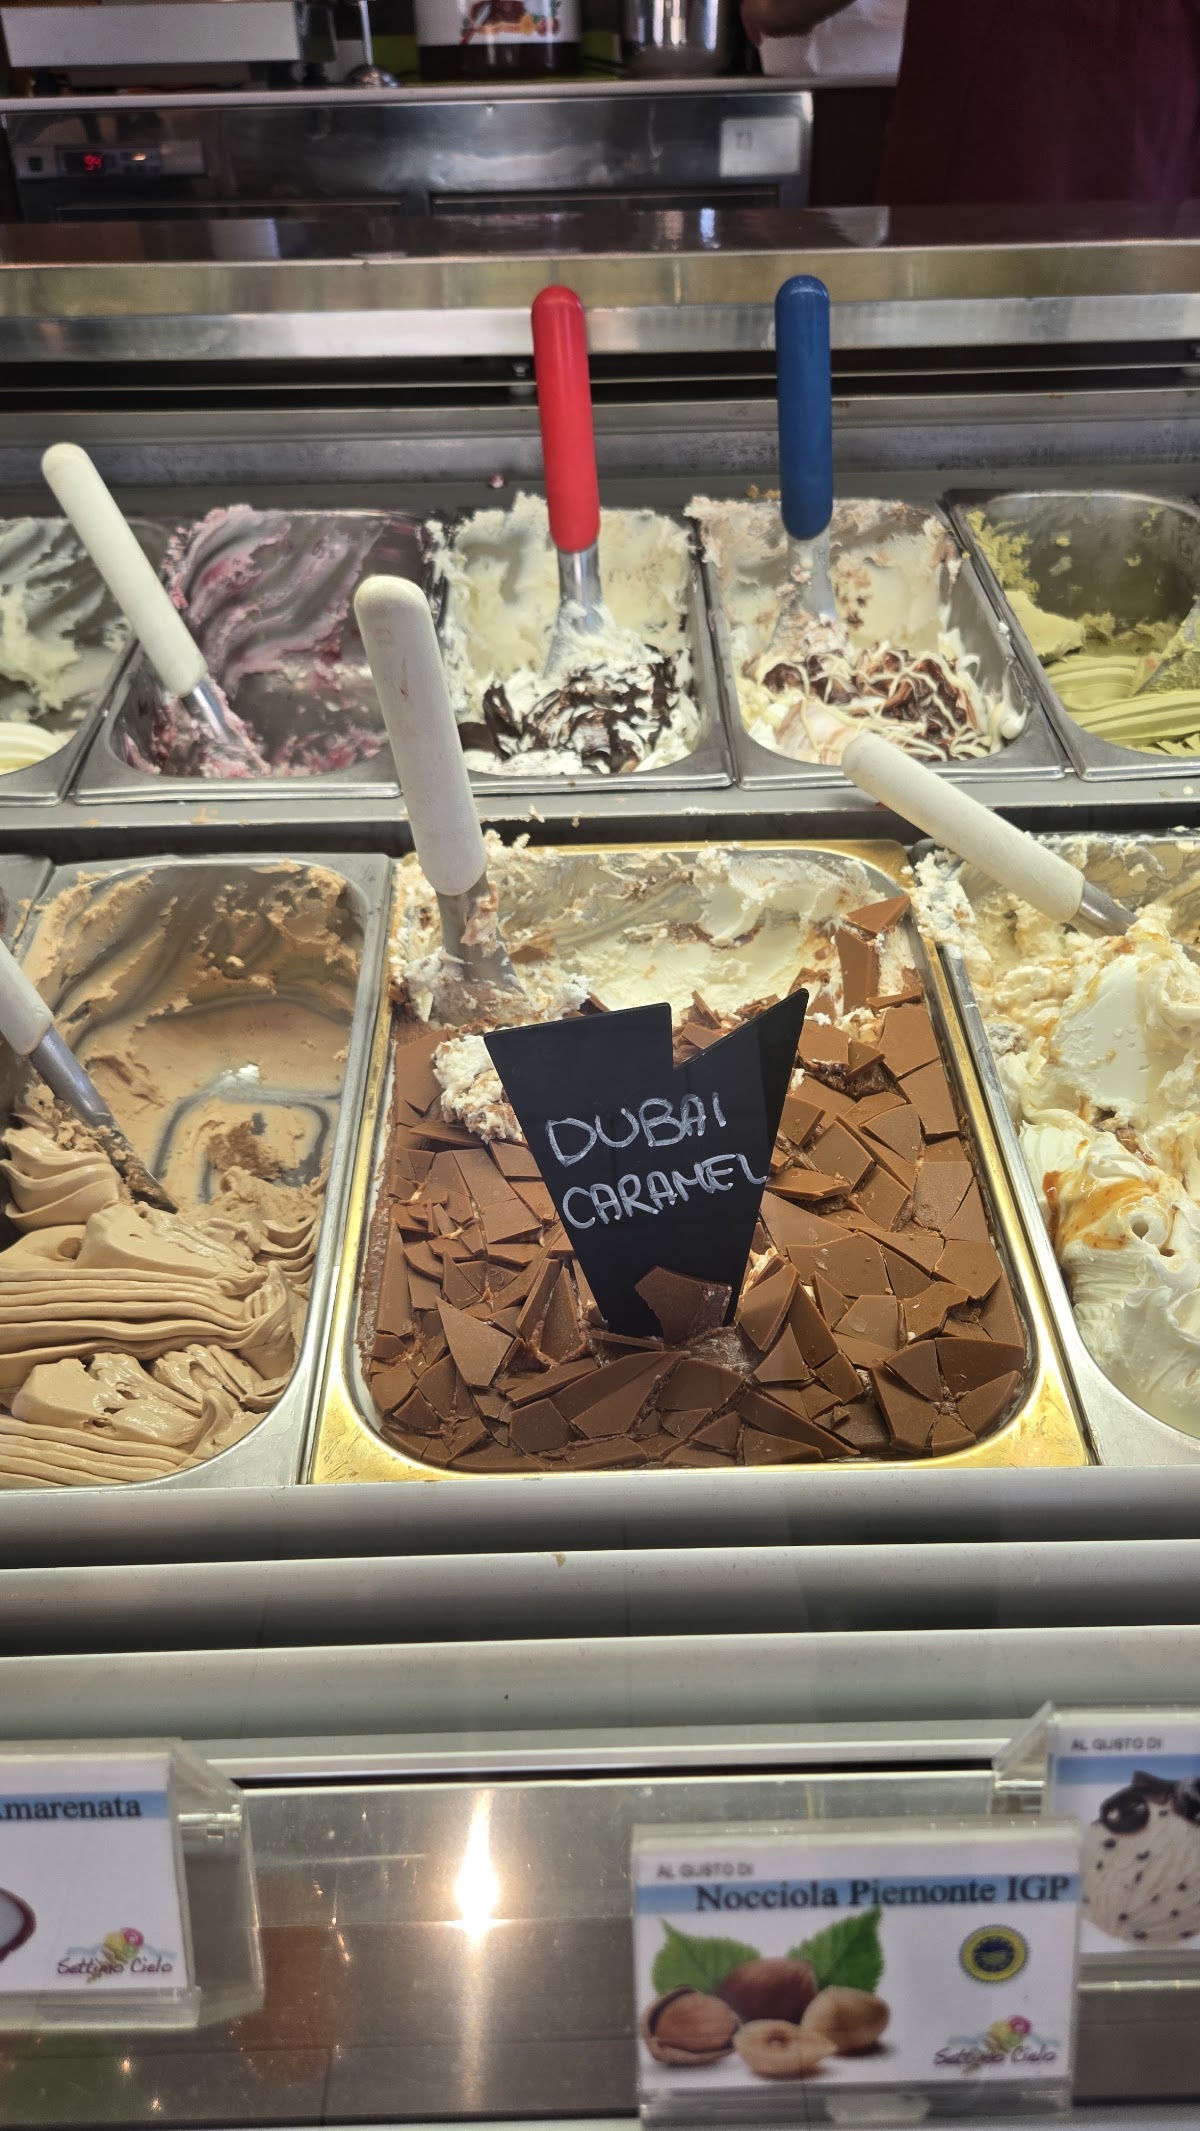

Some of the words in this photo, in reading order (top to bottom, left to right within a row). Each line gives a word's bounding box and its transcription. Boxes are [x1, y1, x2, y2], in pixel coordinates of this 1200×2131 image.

[545, 1092, 727, 1168] DUBAI
[562, 1153, 768, 1229] CARAMEL
[1071, 1738, 1088, 1751] AL
[1092, 1737, 1143, 1751] GUSTO
[1147, 1737, 1163, 1749] DI
[0, 1796, 142, 1820] marenata
[657, 1864, 675, 1878] AL
[679, 1862, 735, 1878] GUSTO
[695, 1880, 839, 1912] Nocciola
[849, 1876, 997, 1907] Piemonte
[1006, 1873, 1071, 1901] IGP
[130, 1955, 173, 1974] Cielo
